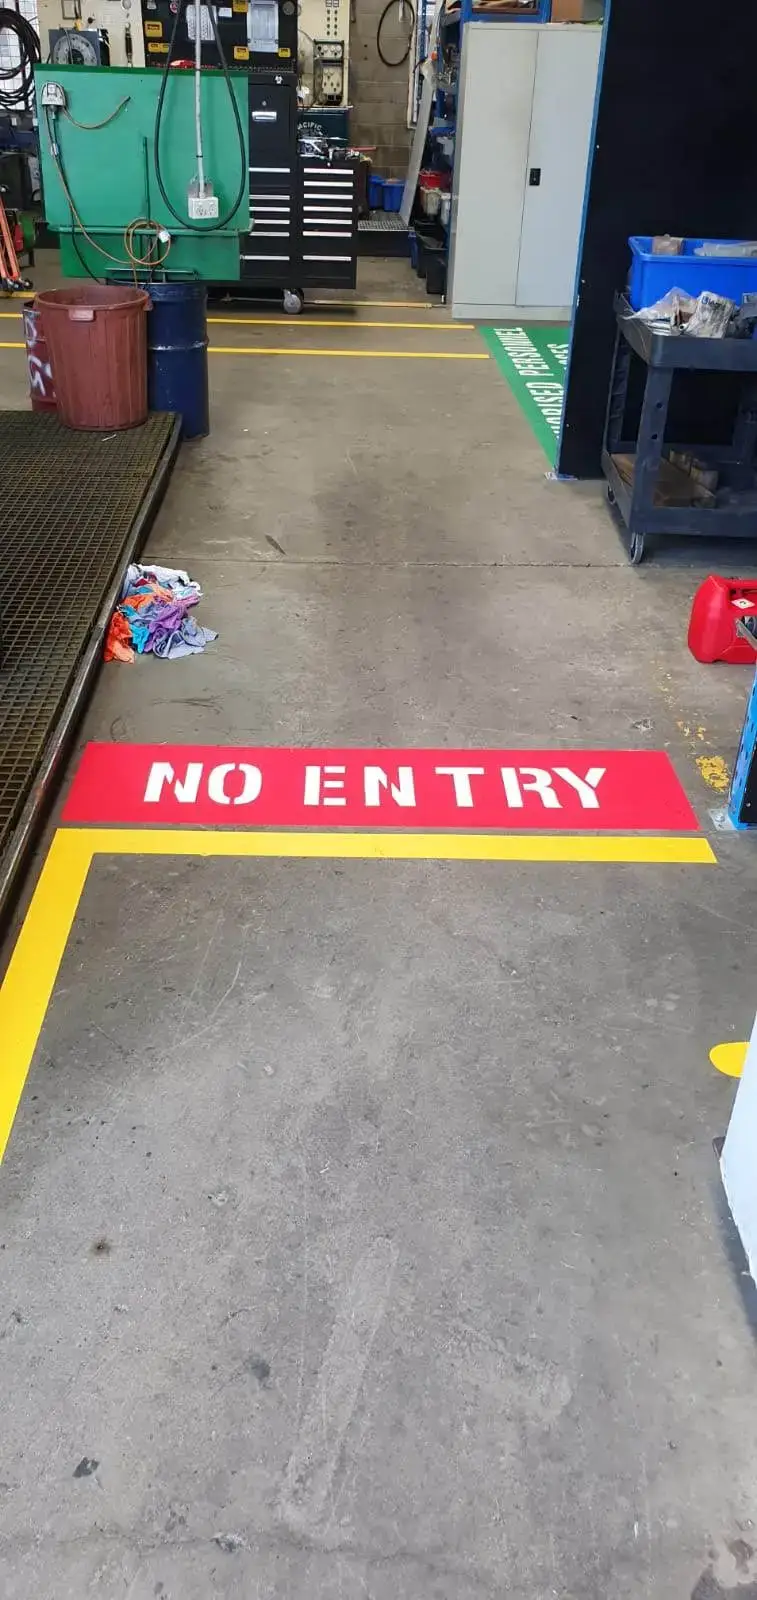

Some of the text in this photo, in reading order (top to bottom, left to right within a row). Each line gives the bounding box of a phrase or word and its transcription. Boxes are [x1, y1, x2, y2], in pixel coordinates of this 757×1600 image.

[493, 327, 554, 375] PERSONNEL
[144, 762, 606, 808] NO ENTRY
